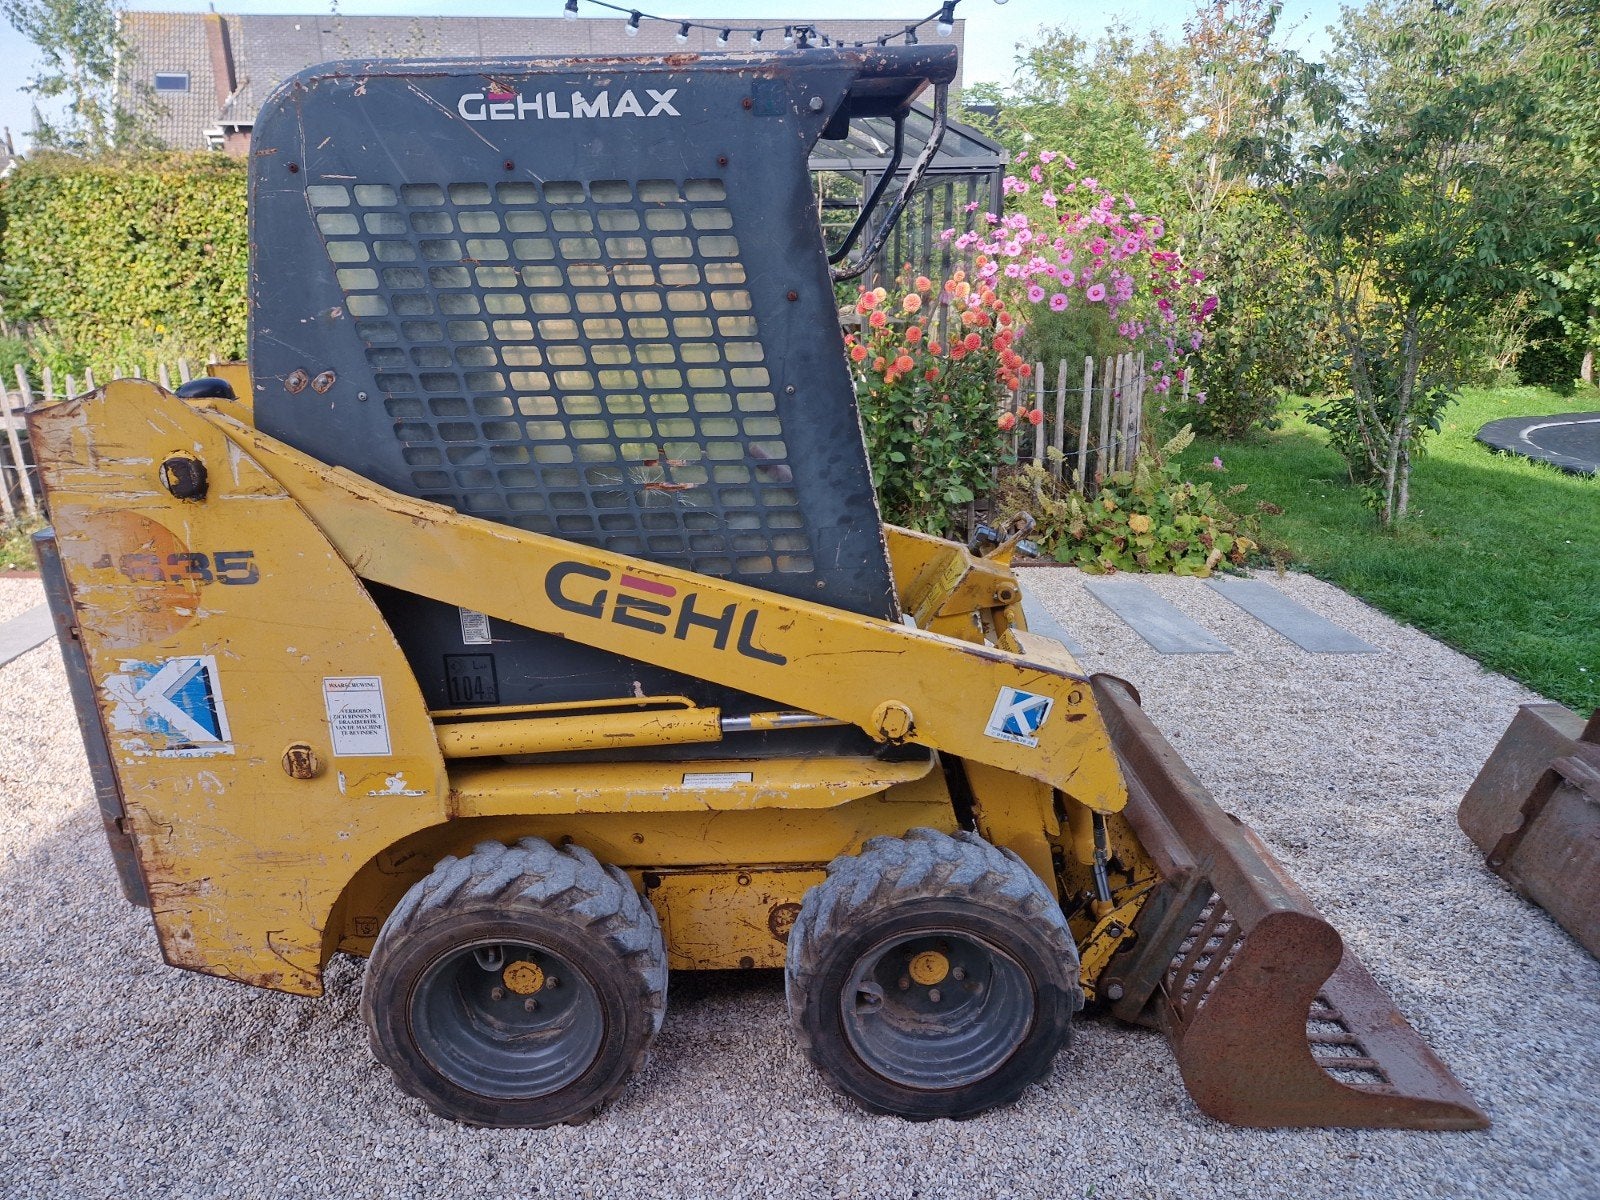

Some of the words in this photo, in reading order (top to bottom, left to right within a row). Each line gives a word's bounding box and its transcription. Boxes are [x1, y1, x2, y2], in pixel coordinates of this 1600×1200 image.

[458, 88, 681, 121] GEHLMAX
[544, 560, 788, 667] GEHL
[452, 675, 485, 701] 104
[990, 687, 1048, 737] K
